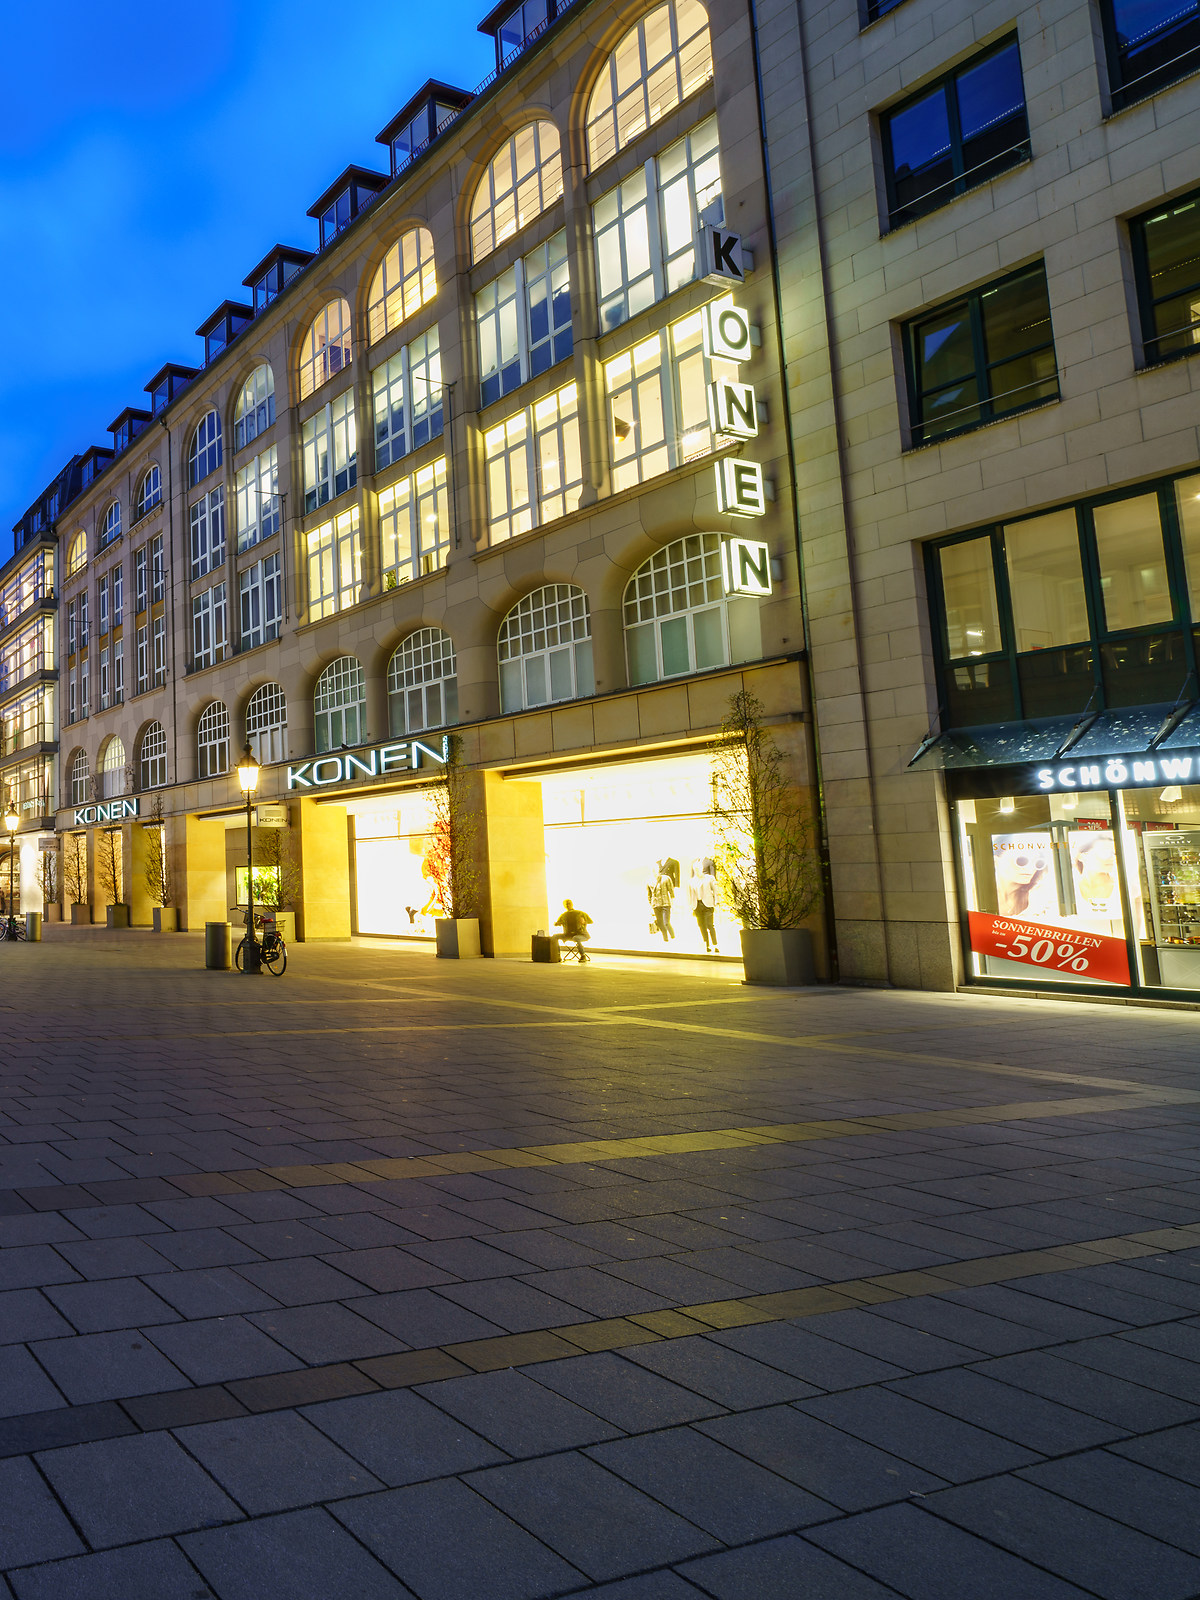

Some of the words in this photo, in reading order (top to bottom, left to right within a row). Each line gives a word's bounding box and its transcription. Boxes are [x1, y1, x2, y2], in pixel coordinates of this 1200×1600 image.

[711, 231, 770, 590] KONEN
[287, 735, 449, 790] KONEN
[1037, 757, 1200, 789] SCHÖNW
[73, 798, 140, 825] KONEN
[991, 919, 1103, 949] SONNENBRILLEN
[995, 934, 1090, 972] -50%
